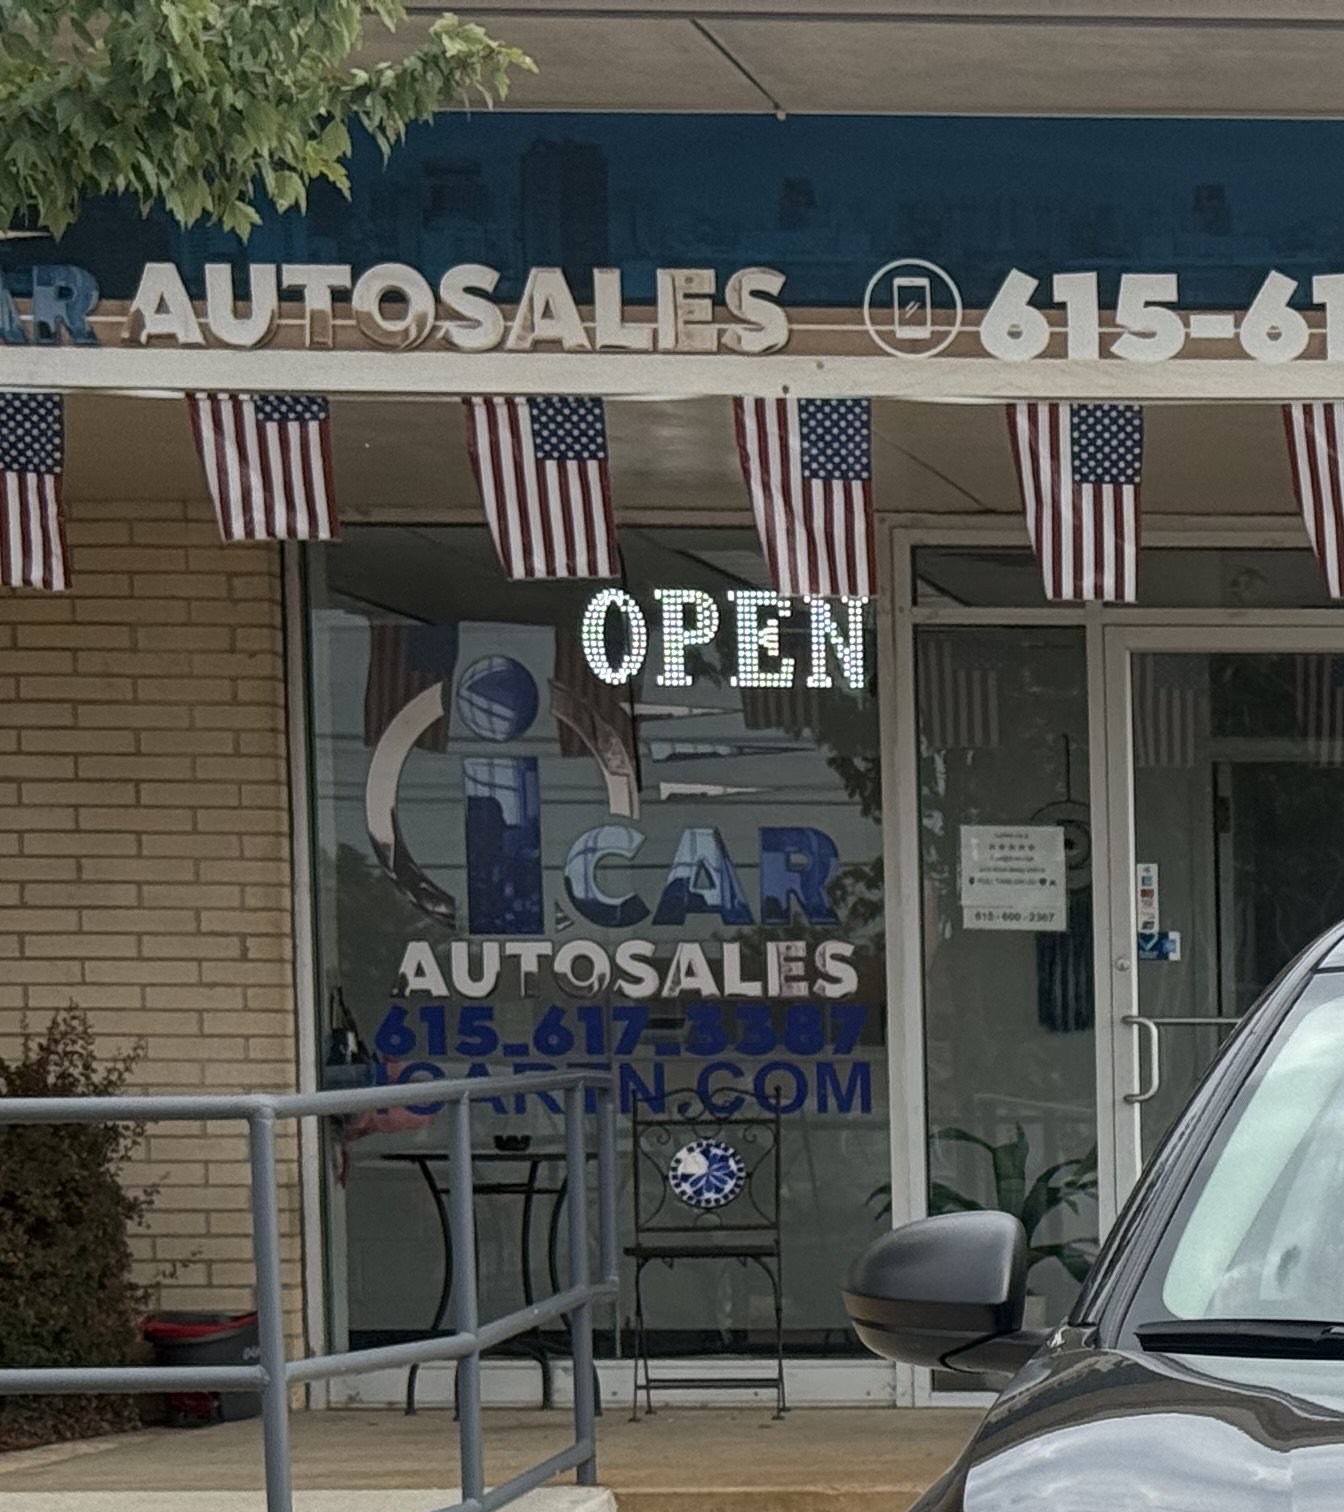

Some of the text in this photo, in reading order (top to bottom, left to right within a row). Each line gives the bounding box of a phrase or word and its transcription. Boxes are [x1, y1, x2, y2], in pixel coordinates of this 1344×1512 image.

[0, 264, 98, 345] R
[121, 262, 789, 353] AUTOSALES
[580, 587, 870, 690] OPEN
[391, 940, 859, 998] AUTOSALES
